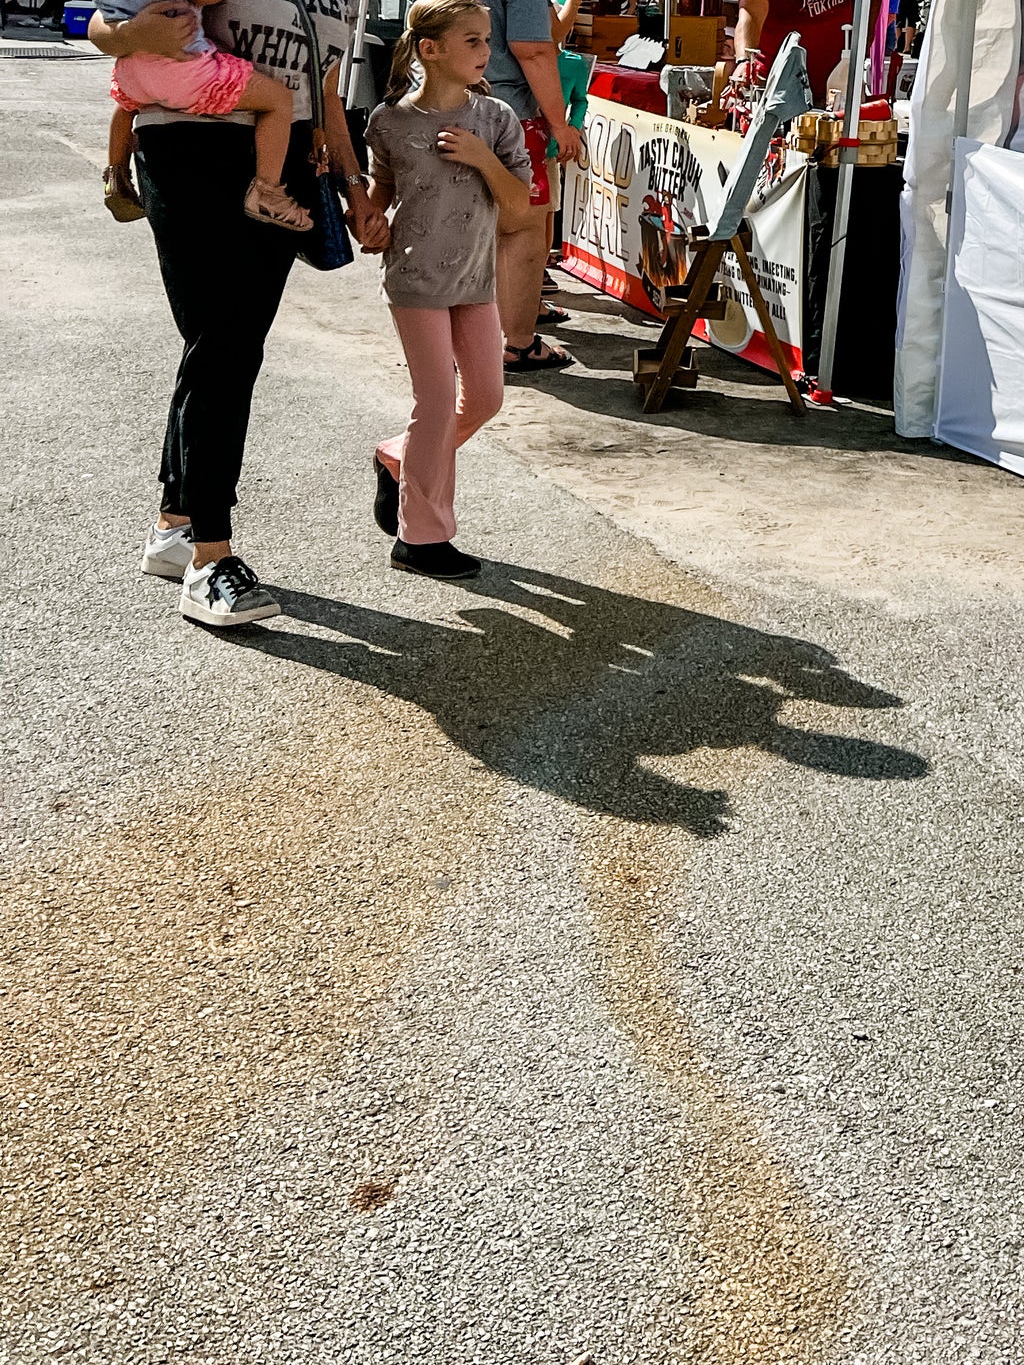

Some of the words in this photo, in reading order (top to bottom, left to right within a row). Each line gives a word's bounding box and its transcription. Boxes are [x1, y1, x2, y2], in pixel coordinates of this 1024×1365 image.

[577, 110, 637, 189] SOLD
[639, 137, 670, 171] TASTY
[672, 141, 703, 192] CAJUN
[648, 165, 686, 202] BUTTER
[571, 173, 630, 262] HERE
[762, 259, 797, 285] INJECTING,
